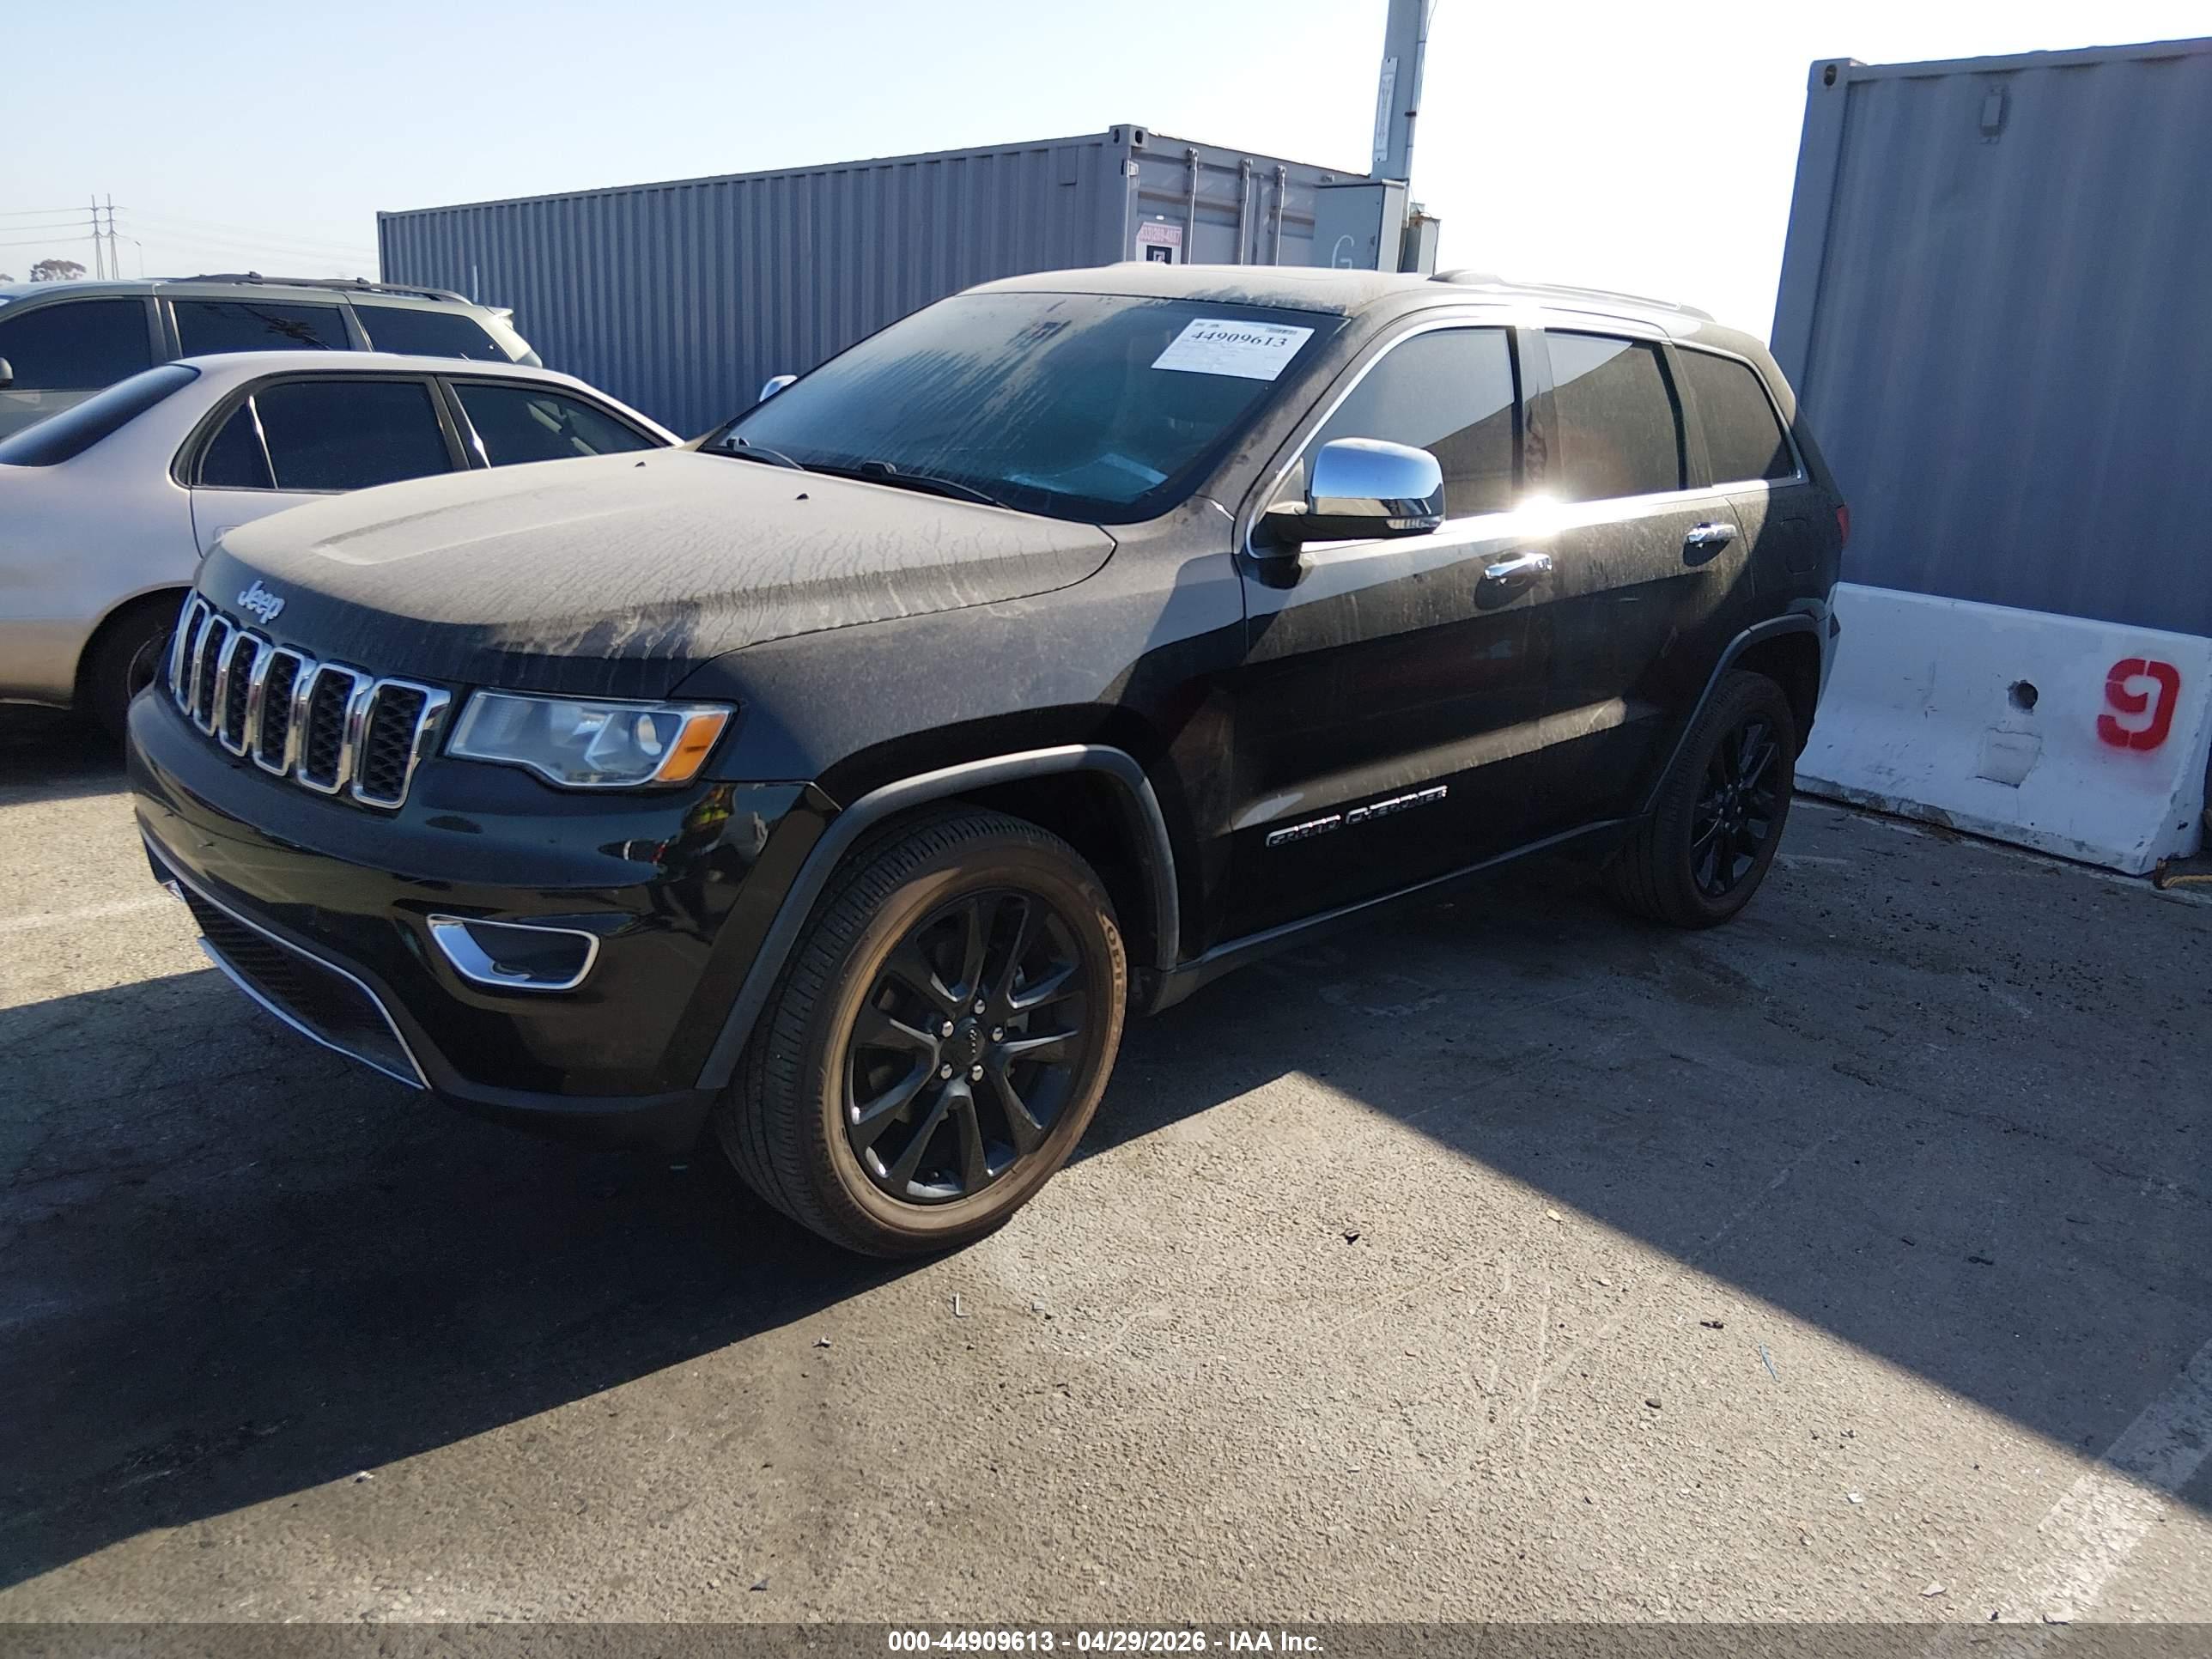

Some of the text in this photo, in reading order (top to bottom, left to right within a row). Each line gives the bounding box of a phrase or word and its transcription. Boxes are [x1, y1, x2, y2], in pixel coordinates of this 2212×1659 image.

[1332, 234, 1354, 269] G
[1191, 331, 1287, 347] 44909613
[238, 580, 285, 624] Jeep
[2097, 658, 2180, 751] 9
